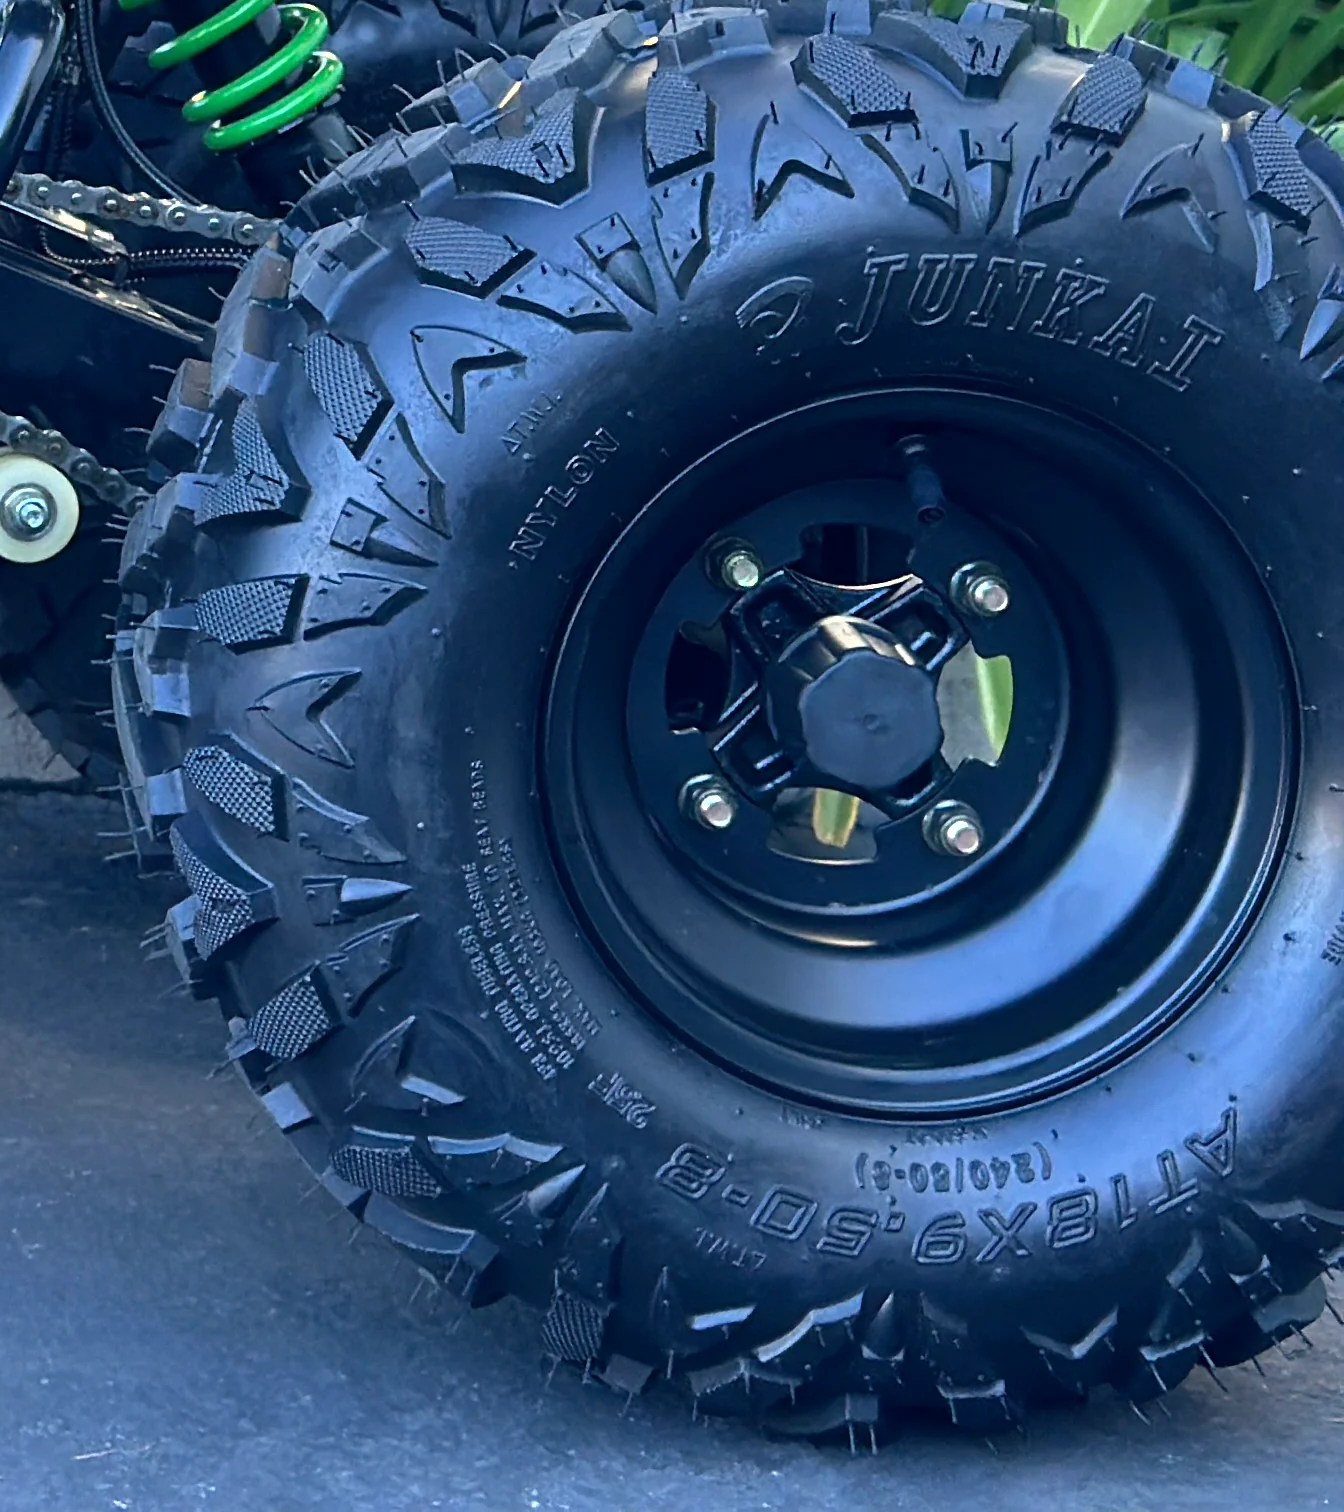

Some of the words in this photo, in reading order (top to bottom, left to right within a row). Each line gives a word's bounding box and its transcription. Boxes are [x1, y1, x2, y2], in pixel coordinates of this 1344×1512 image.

[835, 254, 1225, 392] JUNKAI
[509, 427, 621, 561] NYLON
[655, 1106, 1241, 1265] AT18X9.50-8
